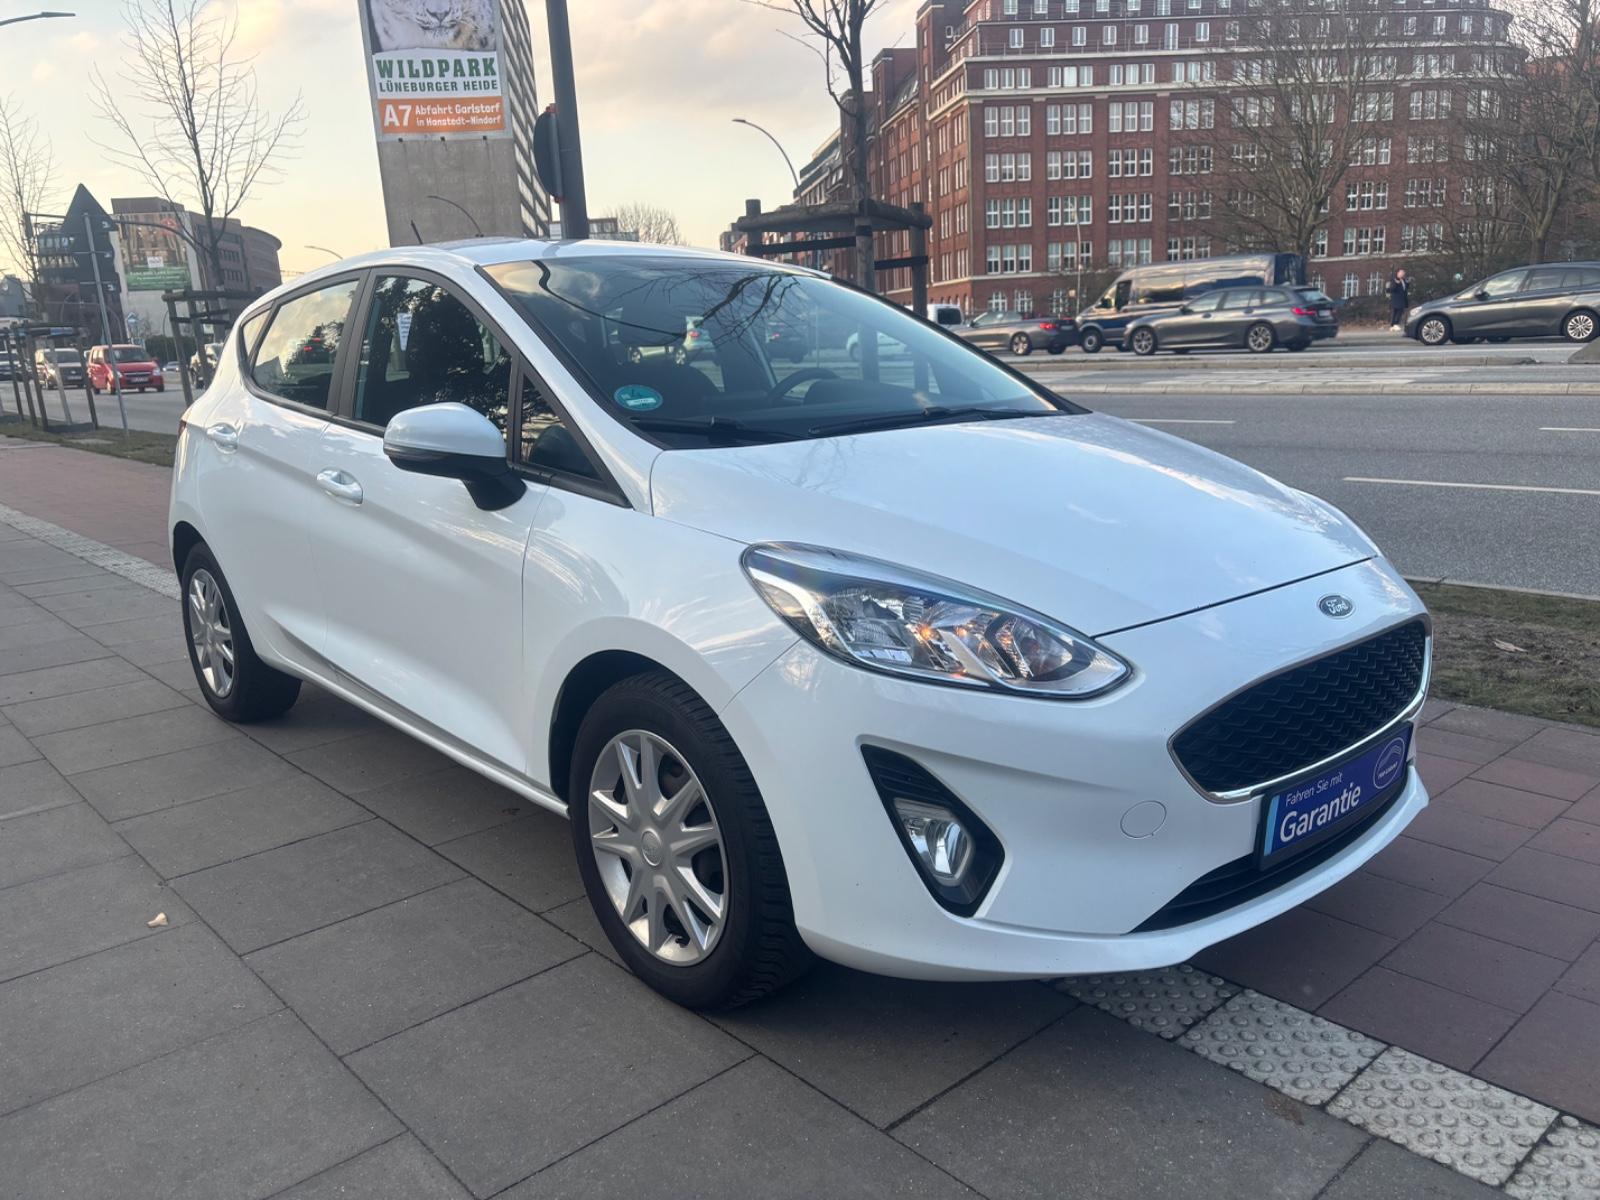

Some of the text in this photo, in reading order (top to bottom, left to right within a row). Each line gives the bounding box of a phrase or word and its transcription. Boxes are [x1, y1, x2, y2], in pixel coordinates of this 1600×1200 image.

[375, 57, 497, 79] WILDPARK
[379, 79, 498, 93] LÜNEBURGER HEIDE
[383, 104, 412, 127] A7
[415, 102, 501, 115] Abfahrt Garlstorf
[416, 117, 425, 126] in
[1325, 599, 1349, 614] Ford
[1286, 772, 1343, 807] Fahren Sie mit
[1280, 782, 1361, 842] Garantie
